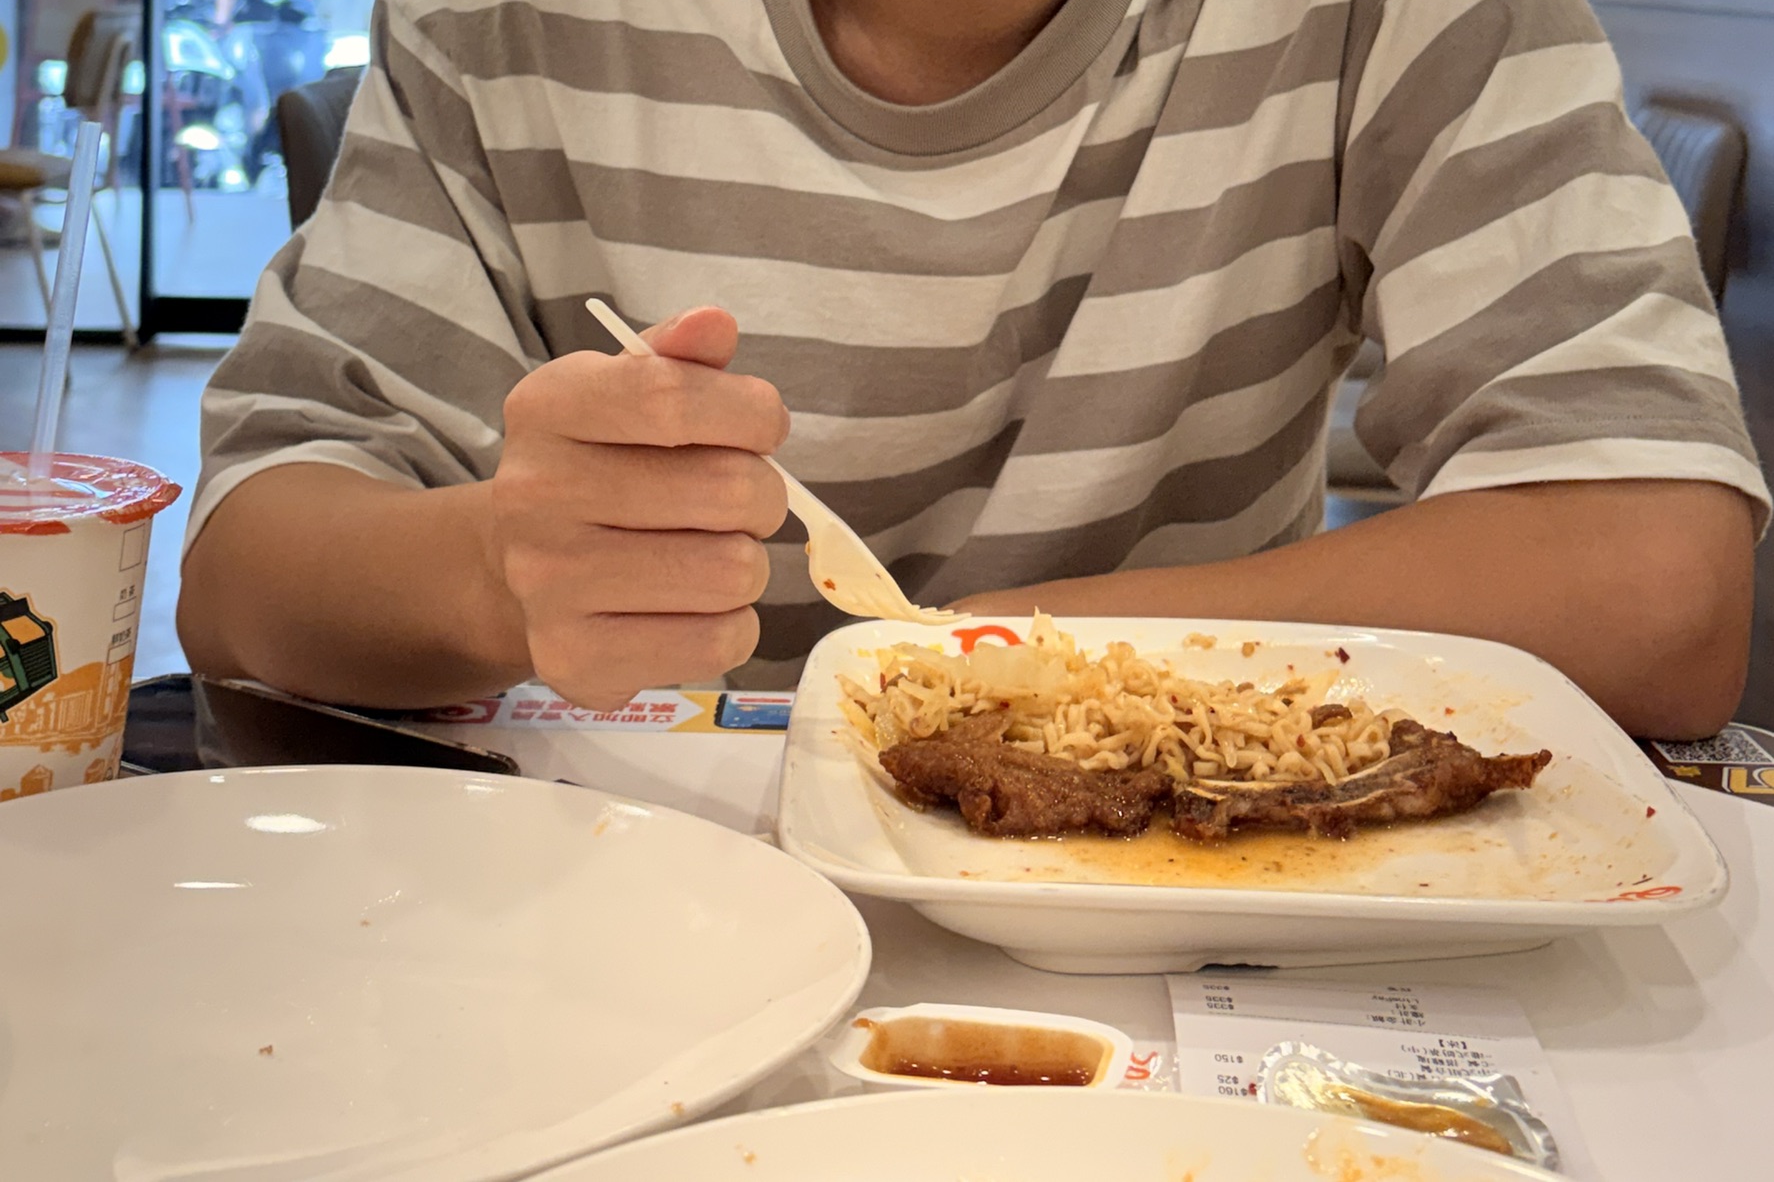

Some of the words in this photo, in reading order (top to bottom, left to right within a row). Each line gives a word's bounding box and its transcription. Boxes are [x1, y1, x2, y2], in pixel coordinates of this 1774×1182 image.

[511, 711, 676, 723] 立即加入會員
[1206, 1002, 1235, 1010] $335
[1214, 1053, 1243, 1064] $150
[1217, 1074, 1239, 1085] $25
[1217, 1085, 1249, 1097] $160
